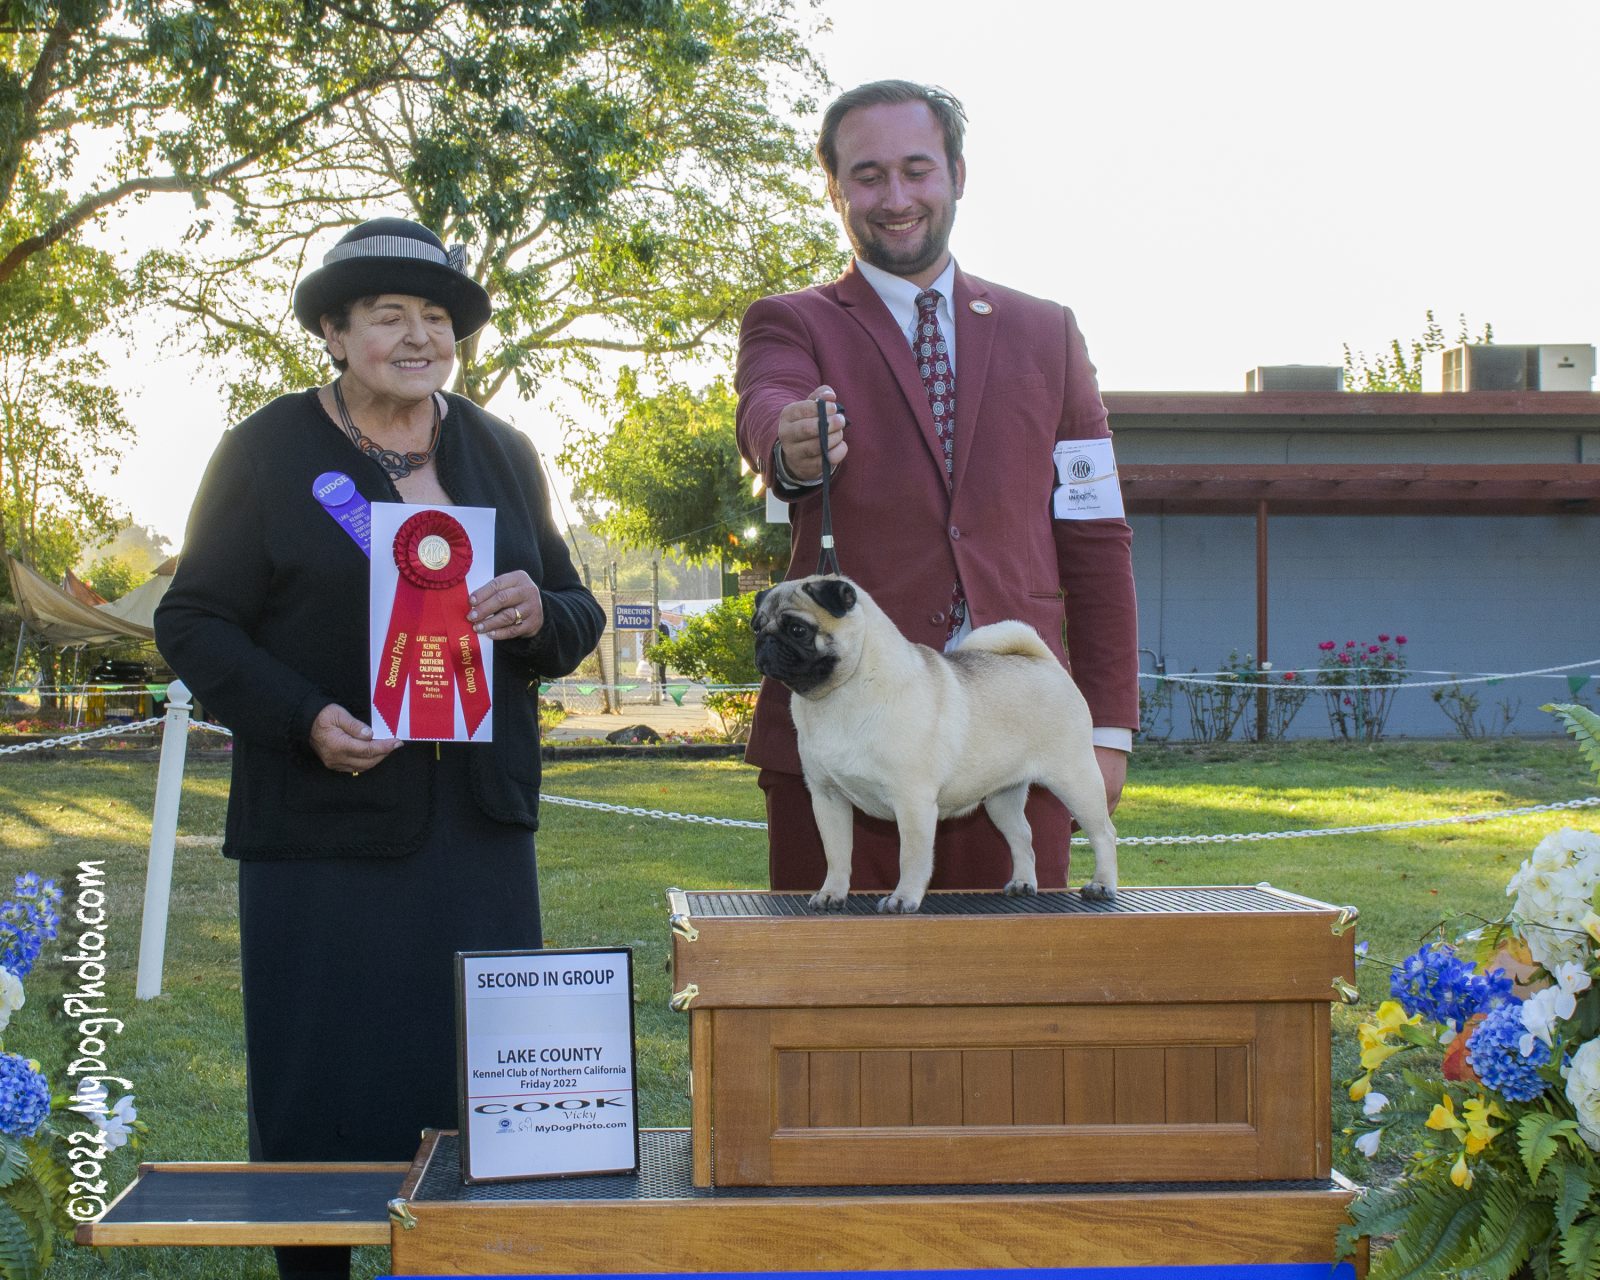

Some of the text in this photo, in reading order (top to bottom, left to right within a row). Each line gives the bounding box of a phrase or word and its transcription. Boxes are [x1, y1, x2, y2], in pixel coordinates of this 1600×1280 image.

[318, 474, 349, 498] JUDGE
[350, 503, 368, 515] COUNTY
[617, 614, 642, 625] PATIO
[429, 635, 448, 643] COUNTY
[385, 632, 408, 688] Second Prize
[459, 634, 477, 694] Variety Group
[477, 969, 615, 988] SECOND IN GROUP
[497, 1047, 603, 1064] LAKE COUNTY
[472, 1065, 627, 1079] Kennel Club of Northern California
[520, 1078, 577, 1091] Friday 2022
[474, 1097, 628, 1115] COOK
[562, 1110, 597, 1124] Vicky
[535, 1121, 627, 1133] MyDogPhoto.com
